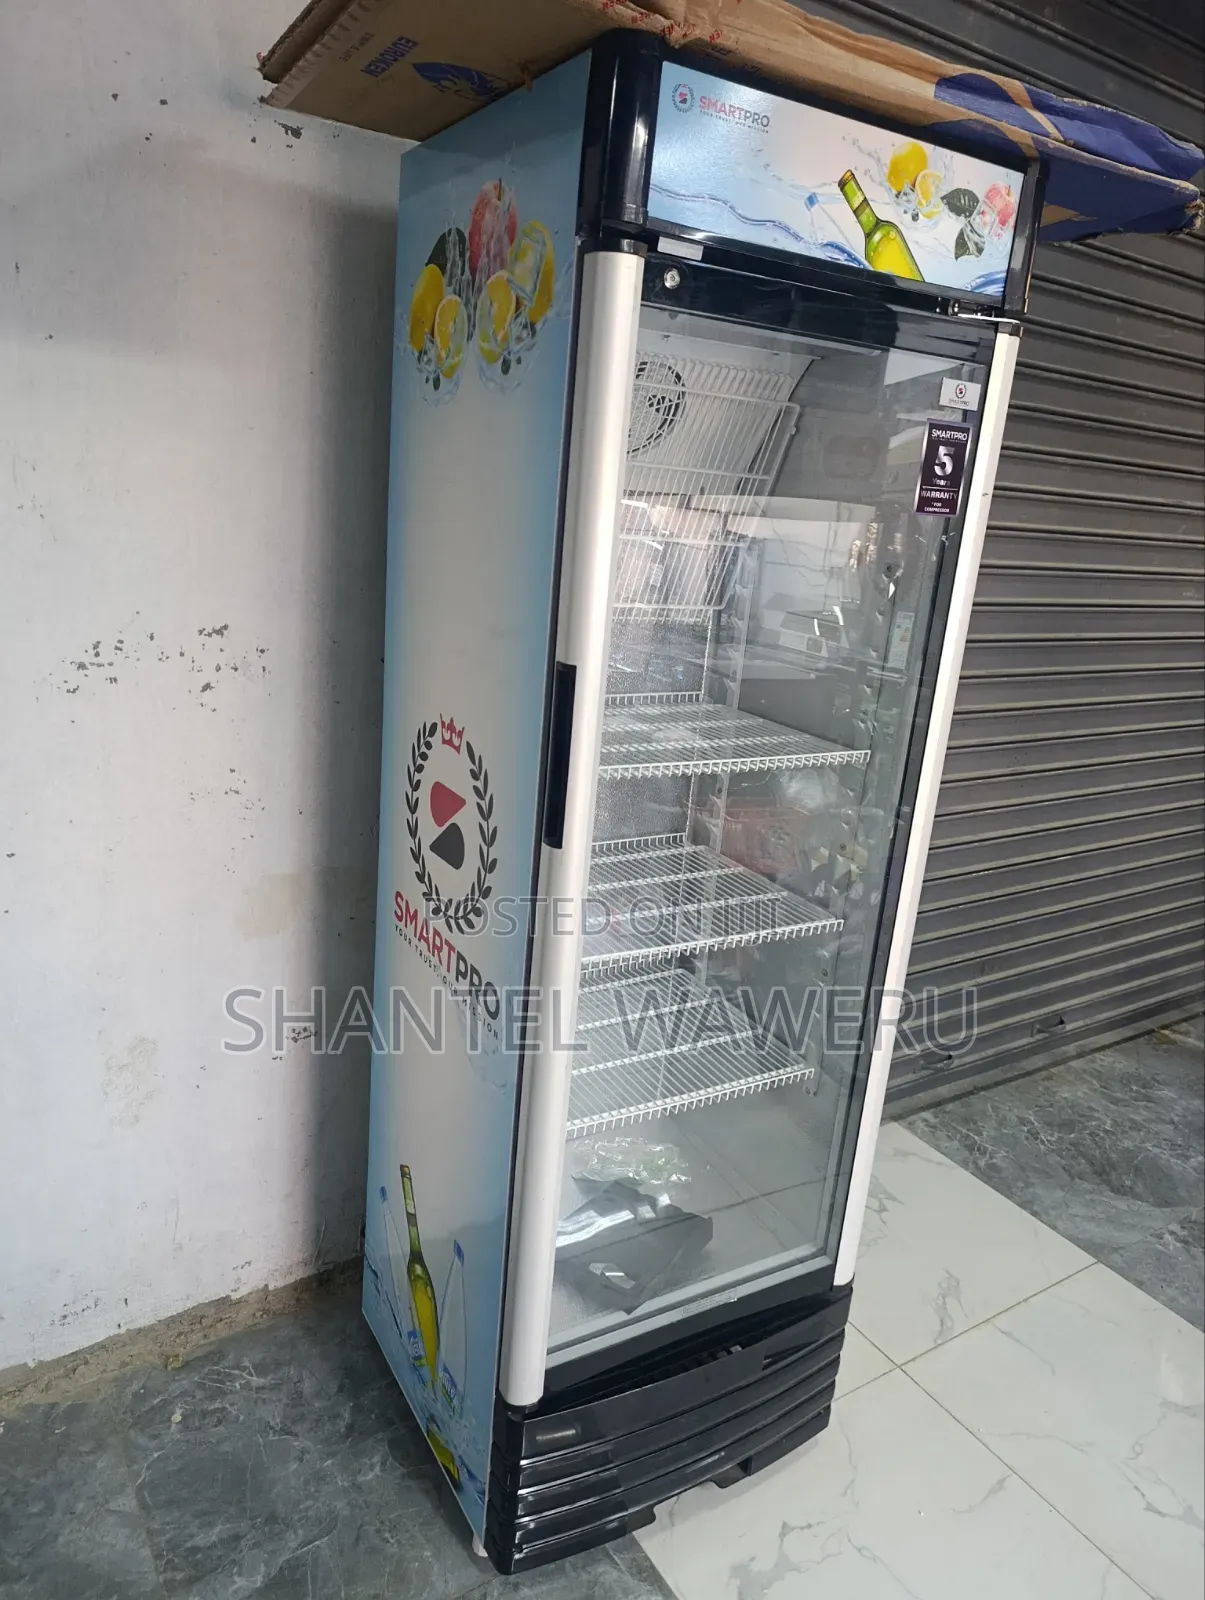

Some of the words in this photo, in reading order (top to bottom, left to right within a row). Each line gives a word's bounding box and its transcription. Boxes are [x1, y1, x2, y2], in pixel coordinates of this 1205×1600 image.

[360, 35, 420, 78] EUROKEN
[699, 95, 770, 127] SMARTPRO
[931, 429, 967, 441] SMARTPRO
[934, 445, 955, 476] 5
[920, 490, 958, 500] WARRANTY
[932, 477, 951, 486] Years
[394, 890, 500, 1021] SMARTPRO
[395, 924, 412, 947] YOUR
[442, 975, 458, 996] OUR
